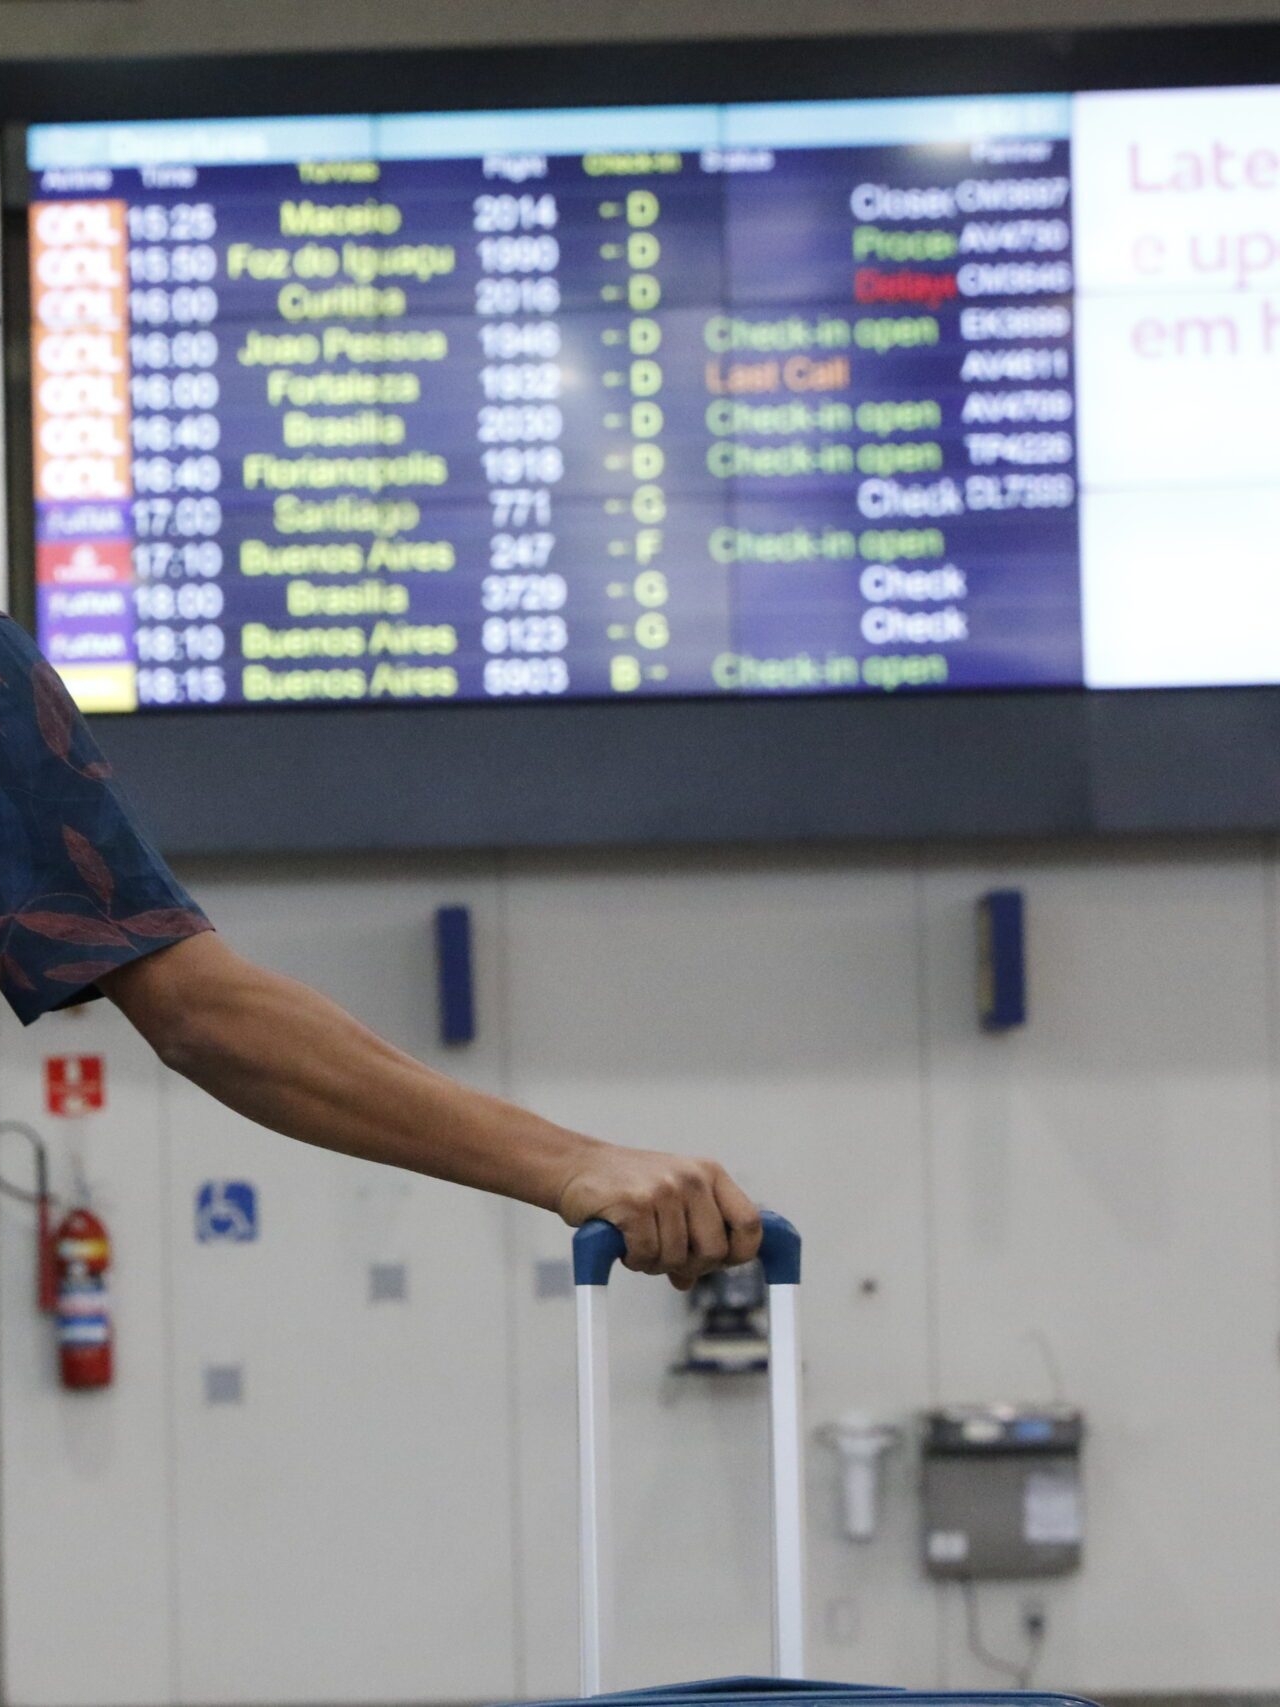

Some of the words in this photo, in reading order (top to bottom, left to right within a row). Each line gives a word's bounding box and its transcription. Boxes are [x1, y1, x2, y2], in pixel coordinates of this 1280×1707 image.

[1127, 139, 1280, 193] Late
[36, 204, 120, 245] GOL
[474, 194, 558, 231] 2014
[627, 190, 659, 227] D
[36, 246, 121, 288] GOL
[228, 243, 291, 281] Foz
[293, 242, 340, 280] do
[627, 232, 660, 269] D
[37, 288, 122, 330] GOL
[278, 283, 407, 322] Curitiba
[628, 273, 661, 311] D
[38, 332, 123, 373] GOL
[323, 326, 448, 363] Pessoa
[629, 318, 662, 355] D
[704, 314, 851, 353] Check-in
[853, 316, 939, 355] open
[1129, 315, 1240, 359] em
[39, 373, 123, 414] GOL
[267, 369, 420, 407] Fortaleza
[630, 359, 662, 397] D
[705, 358, 780, 395] Last
[783, 355, 850, 392] Call
[40, 414, 124, 456] GOL
[631, 401, 663, 438] D
[705, 399, 853, 437] Check-in
[855, 400, 941, 438] open
[41, 455, 125, 498] GOL
[632, 443, 665, 480] D
[706, 440, 854, 478] Check-in
[856, 442, 943, 480] open
[274, 494, 419, 537] Santiago
[489, 488, 552, 528] 771
[632, 484, 667, 524] G
[857, 477, 964, 518] Check
[240, 539, 362, 576] Buenos
[368, 536, 455, 572] Aires
[490, 532, 555, 570] 247
[635, 528, 663, 566] F
[709, 525, 855, 564] Check-in
[859, 527, 945, 563] open
[634, 570, 668, 608] G
[859, 563, 967, 603] Check
[241, 622, 365, 659] Buenos
[369, 619, 458, 655] Aires
[482, 615, 568, 653] 8123
[634, 611, 669, 649] G
[860, 605, 969, 644] Check
[242, 664, 367, 702] Buenos
[369, 660, 459, 698] Aires
[610, 655, 641, 692] B
[711, 651, 858, 689] Check-in
[861, 654, 948, 693] open
